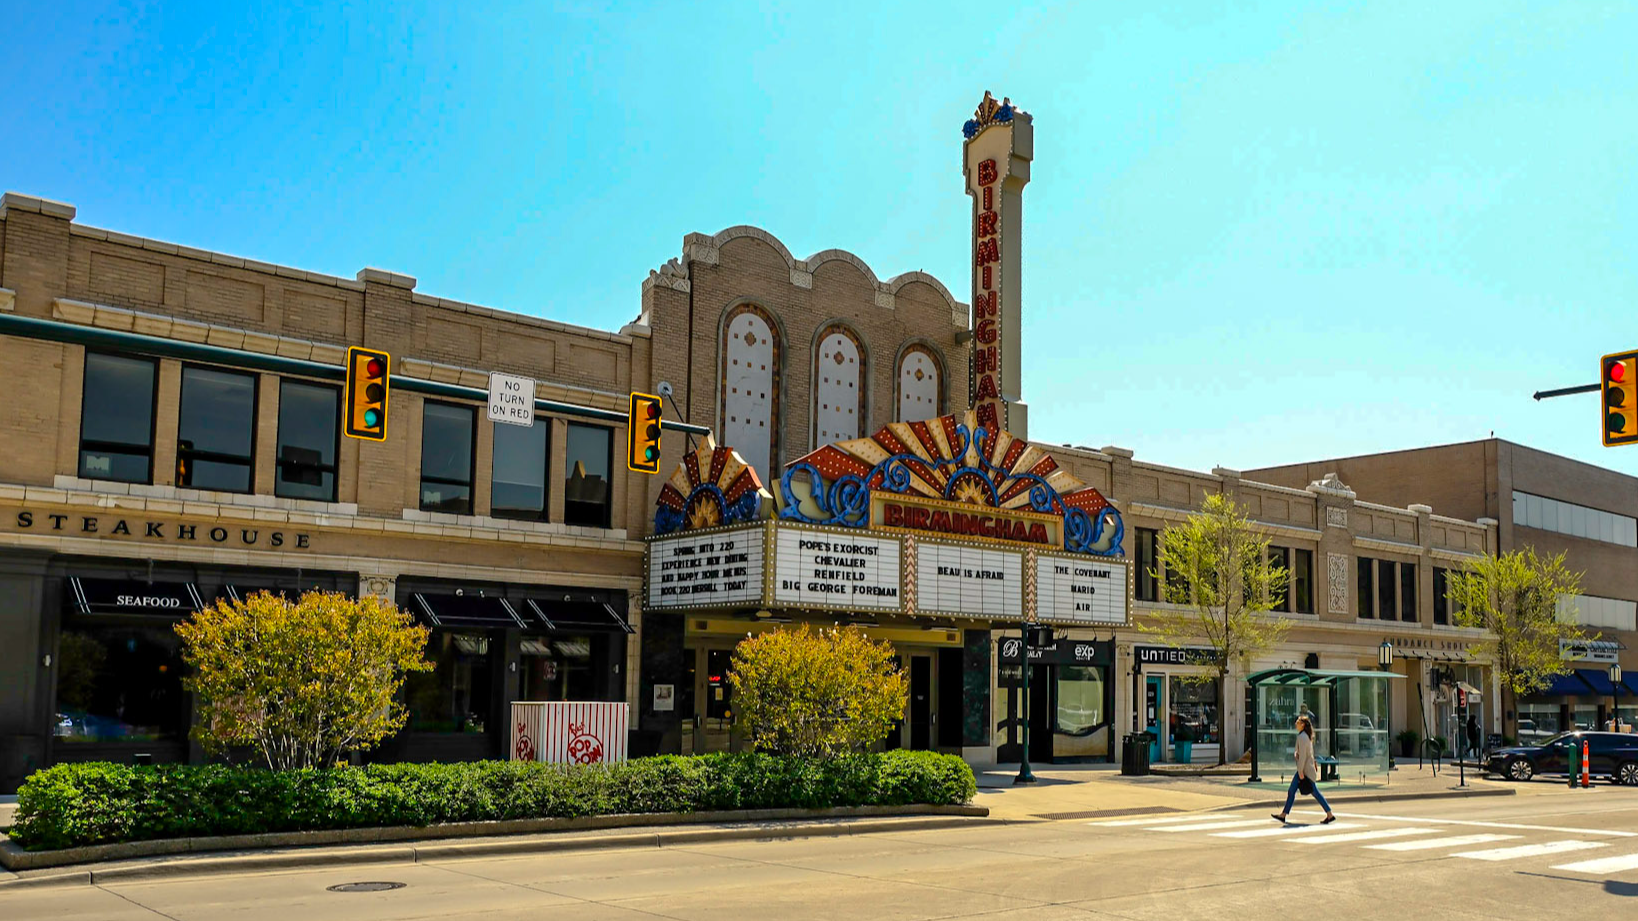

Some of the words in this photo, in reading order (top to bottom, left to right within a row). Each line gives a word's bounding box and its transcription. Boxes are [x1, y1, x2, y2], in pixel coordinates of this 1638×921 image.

[977, 158, 999, 427] BIRMINGHAM
[505, 381, 520, 391] NO
[499, 393, 525, 405] TURN
[493, 405, 505, 415] ON
[510, 408, 529, 419] RED
[17, 511, 310, 548] STEAKHOUSE
[883, 503, 1049, 543] BIRMINGHAM
[699, 543, 714, 553] INTO
[720, 541, 734, 551] 220
[799, 540, 831, 552] POPE'S
[833, 543, 878, 555] EXORCIST
[662, 558, 702, 570] EXPERIENCE
[706, 556, 721, 565] NEW
[725, 553, 748, 564] DINING
[815, 555, 866, 568] CHEVALIER
[662, 574, 674, 583] AND
[678, 571, 699, 582] HAPPY
[702, 570, 719, 579] HOUR
[814, 569, 865, 581] RENFIELD
[938, 566, 960, 576] BEAU
[964, 569, 972, 577] IS
[975, 570, 1004, 580] AFRAID
[1055, 566, 1069, 575] THE
[1074, 568, 1111, 579] COVENANT
[724, 581, 747, 591] TODAY
[782, 580, 800, 590] BIG
[808, 582, 846, 594] GEORGE
[853, 585, 897, 597] FOREMAN
[1071, 584, 1095, 594] MARIO
[116, 595, 180, 608] SEAFOOD
[1075, 602, 1090, 611] AIR
[1075, 645, 1095, 661] exp
[569, 739, 591, 759] POP
